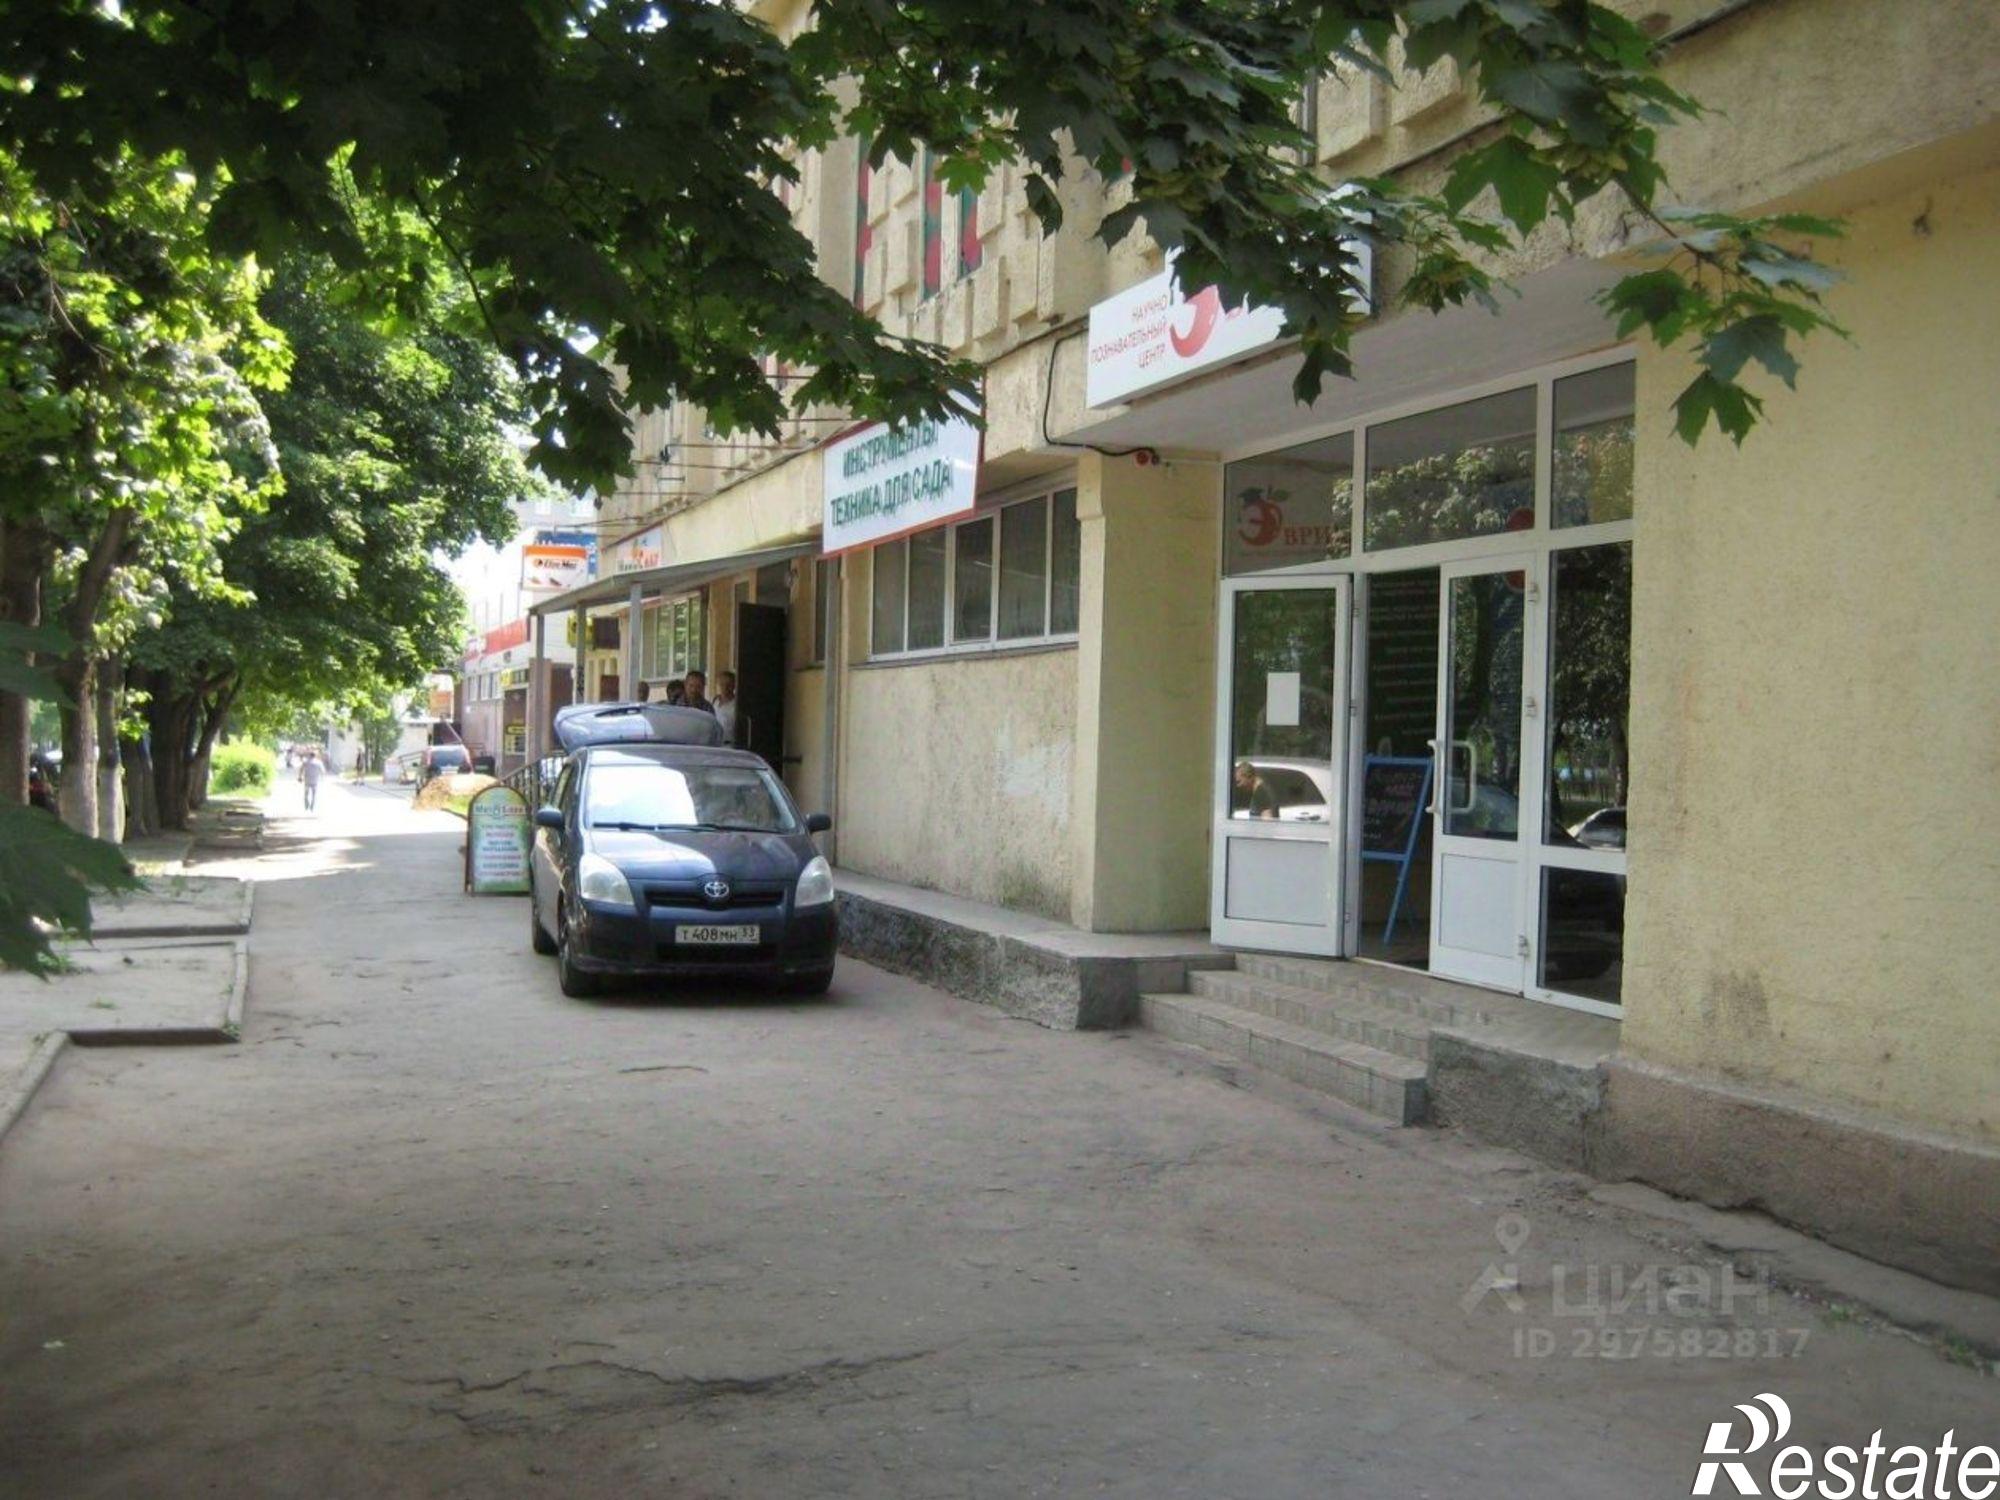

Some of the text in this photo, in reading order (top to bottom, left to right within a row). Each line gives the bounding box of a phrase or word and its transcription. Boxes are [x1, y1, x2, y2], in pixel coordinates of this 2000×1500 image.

[1138, 342, 1167, 369] ЦЕНТР
[831, 457, 954, 527] ТЕХНИКА ДЛЯ САДА
